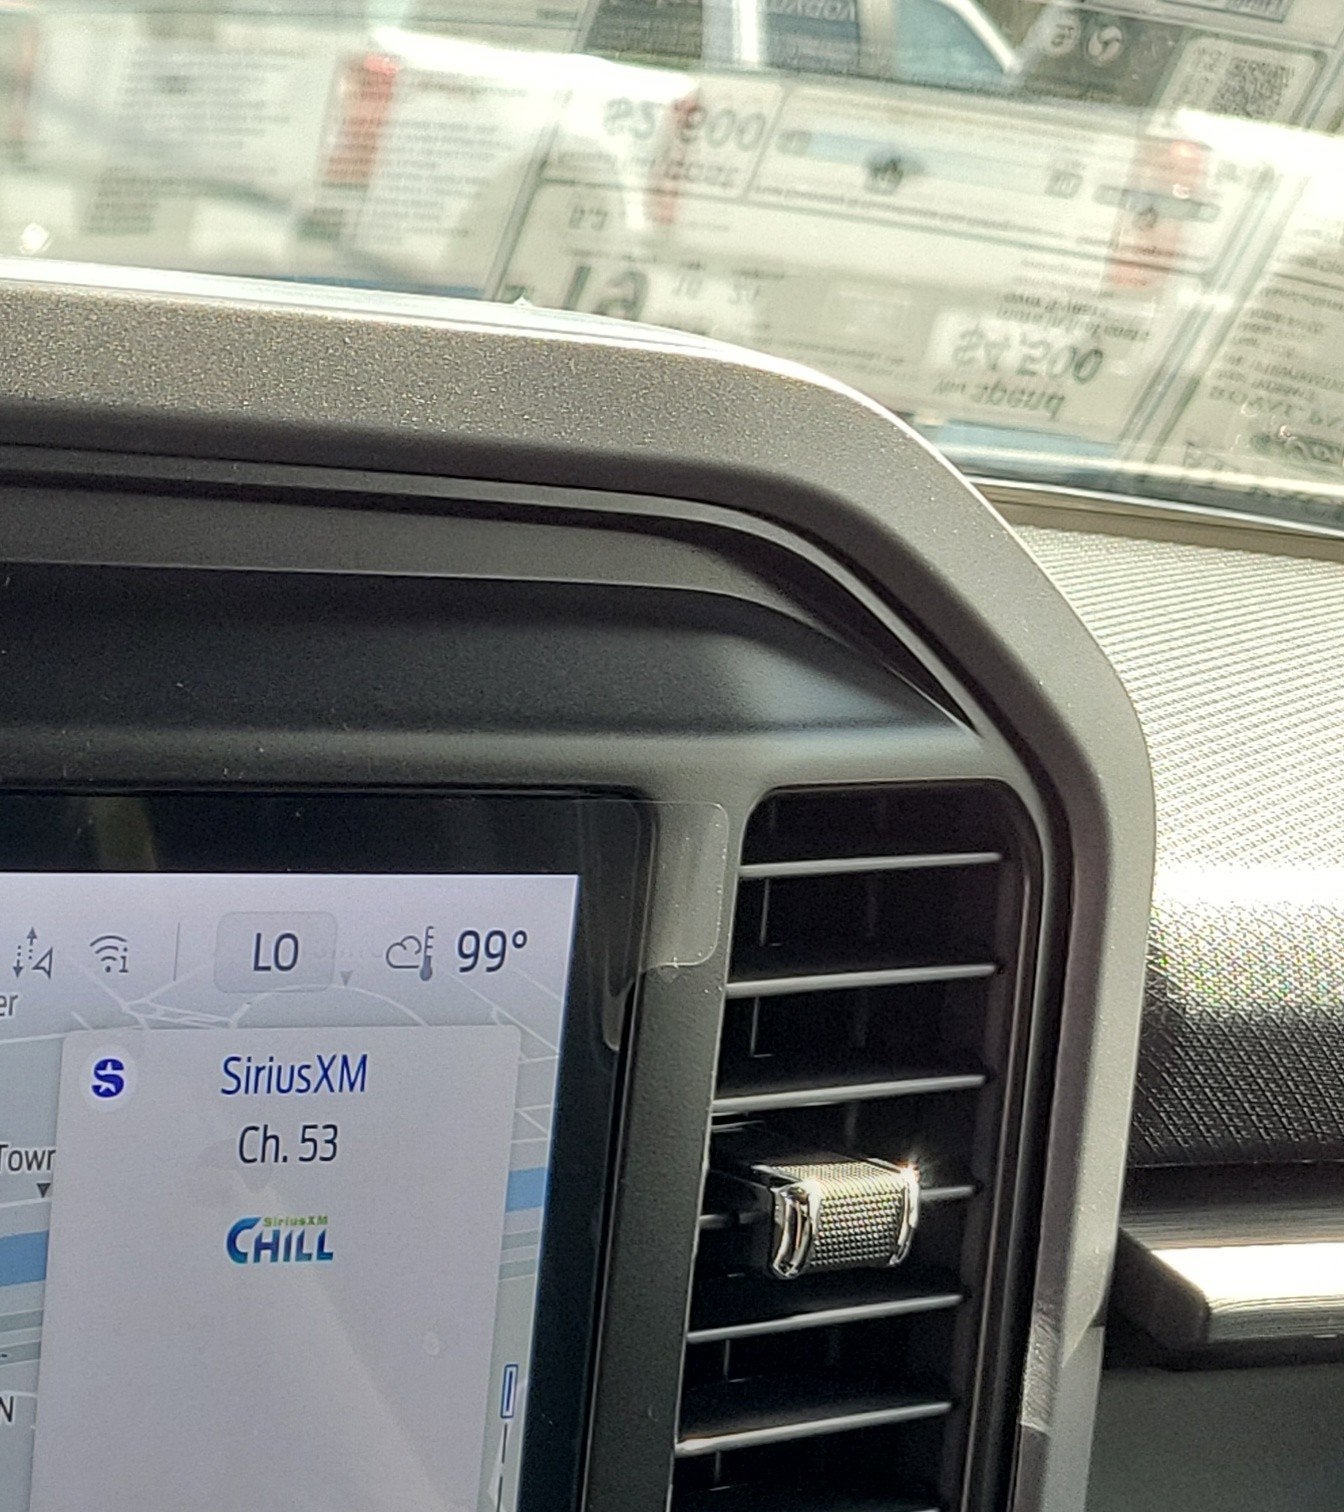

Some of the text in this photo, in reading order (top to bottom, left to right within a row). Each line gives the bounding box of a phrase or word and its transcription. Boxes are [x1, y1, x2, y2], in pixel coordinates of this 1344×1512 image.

[253, 933, 299, 972] LO
[457, 929, 528, 973] 99°
[221, 1054, 368, 1095] SiriusXM
[238, 1125, 338, 1163] Ch. 53
[226, 1217, 334, 1264] CHILL
